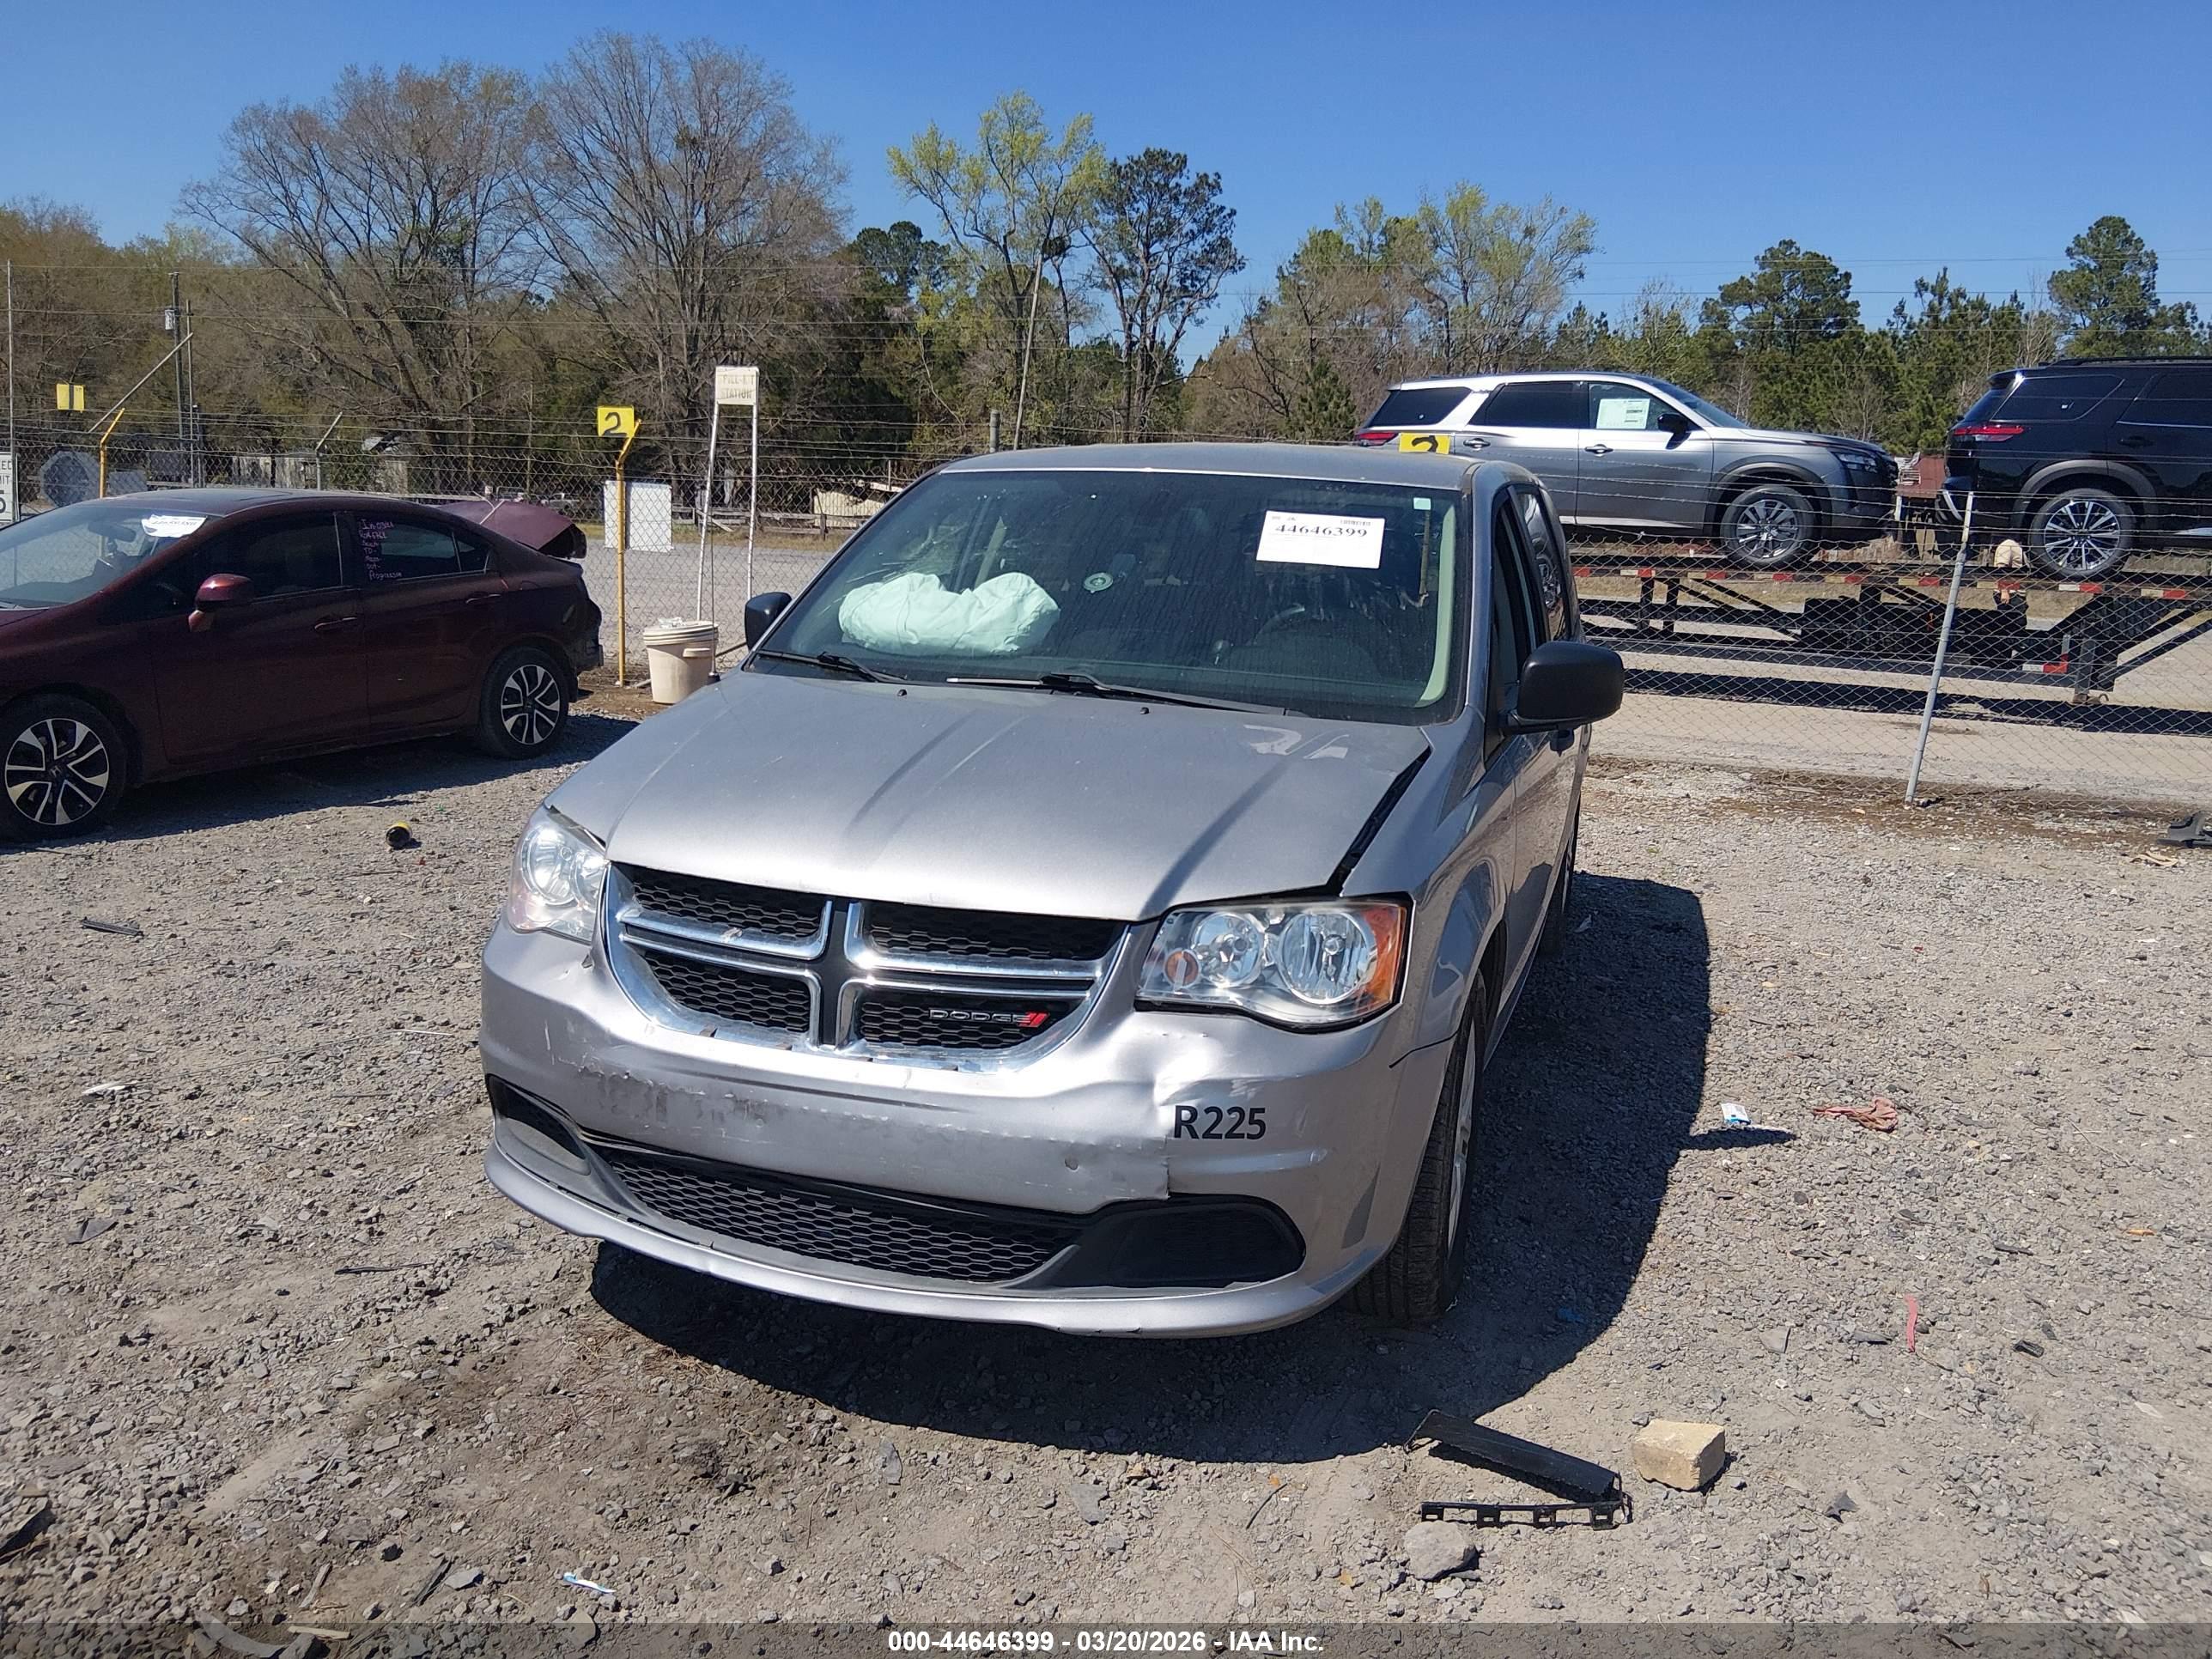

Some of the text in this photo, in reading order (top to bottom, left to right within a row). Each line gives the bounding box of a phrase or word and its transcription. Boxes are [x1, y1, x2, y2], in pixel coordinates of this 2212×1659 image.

[602, 411, 627, 437] 2
[1274, 524, 1368, 538] 44646399
[930, 1009, 1031, 1024] DODGE
[1173, 1105, 1267, 1140] R225
